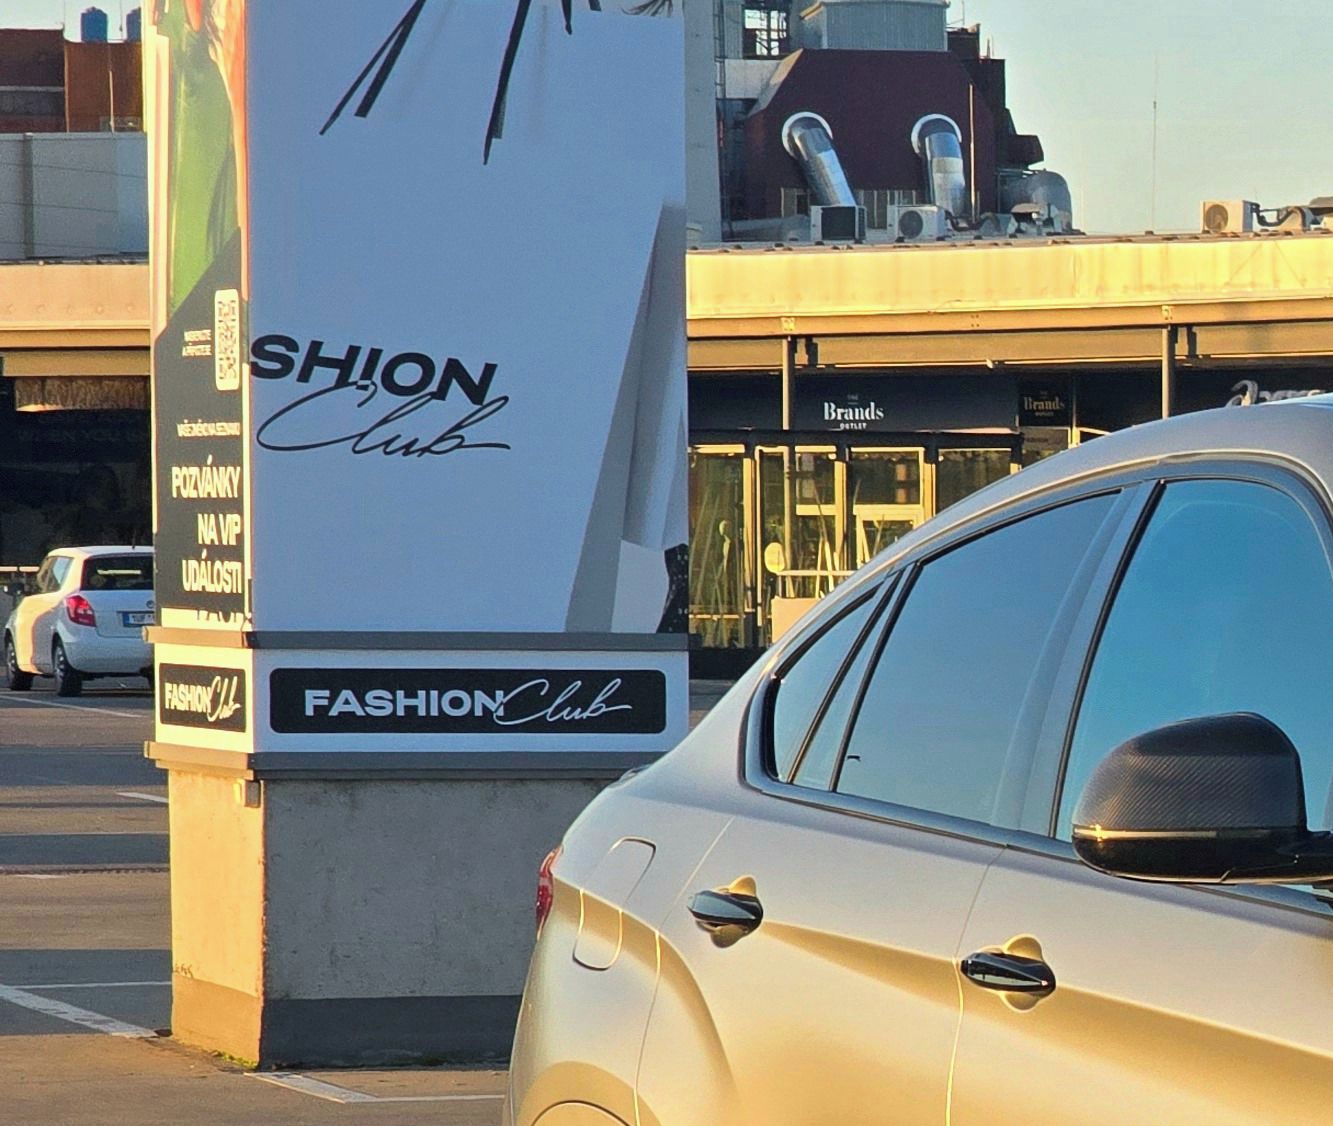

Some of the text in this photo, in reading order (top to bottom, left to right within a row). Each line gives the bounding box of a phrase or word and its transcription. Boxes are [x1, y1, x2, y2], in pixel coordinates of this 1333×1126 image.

[250, 334, 498, 406] SHION
[257, 381, 511, 457] Club
[823, 401, 885, 421] Brands
[1023, 396, 1065, 411] Brands
[839, 422, 867, 430] OUTLET
[171, 454, 241, 498] POZVÁNKY
[198, 513, 241, 546] NA VIP
[182, 549, 243, 594] UDÁLOSTI
[164, 675, 242, 722] FASHION Club
[304, 677, 633, 725] FASHION Club
